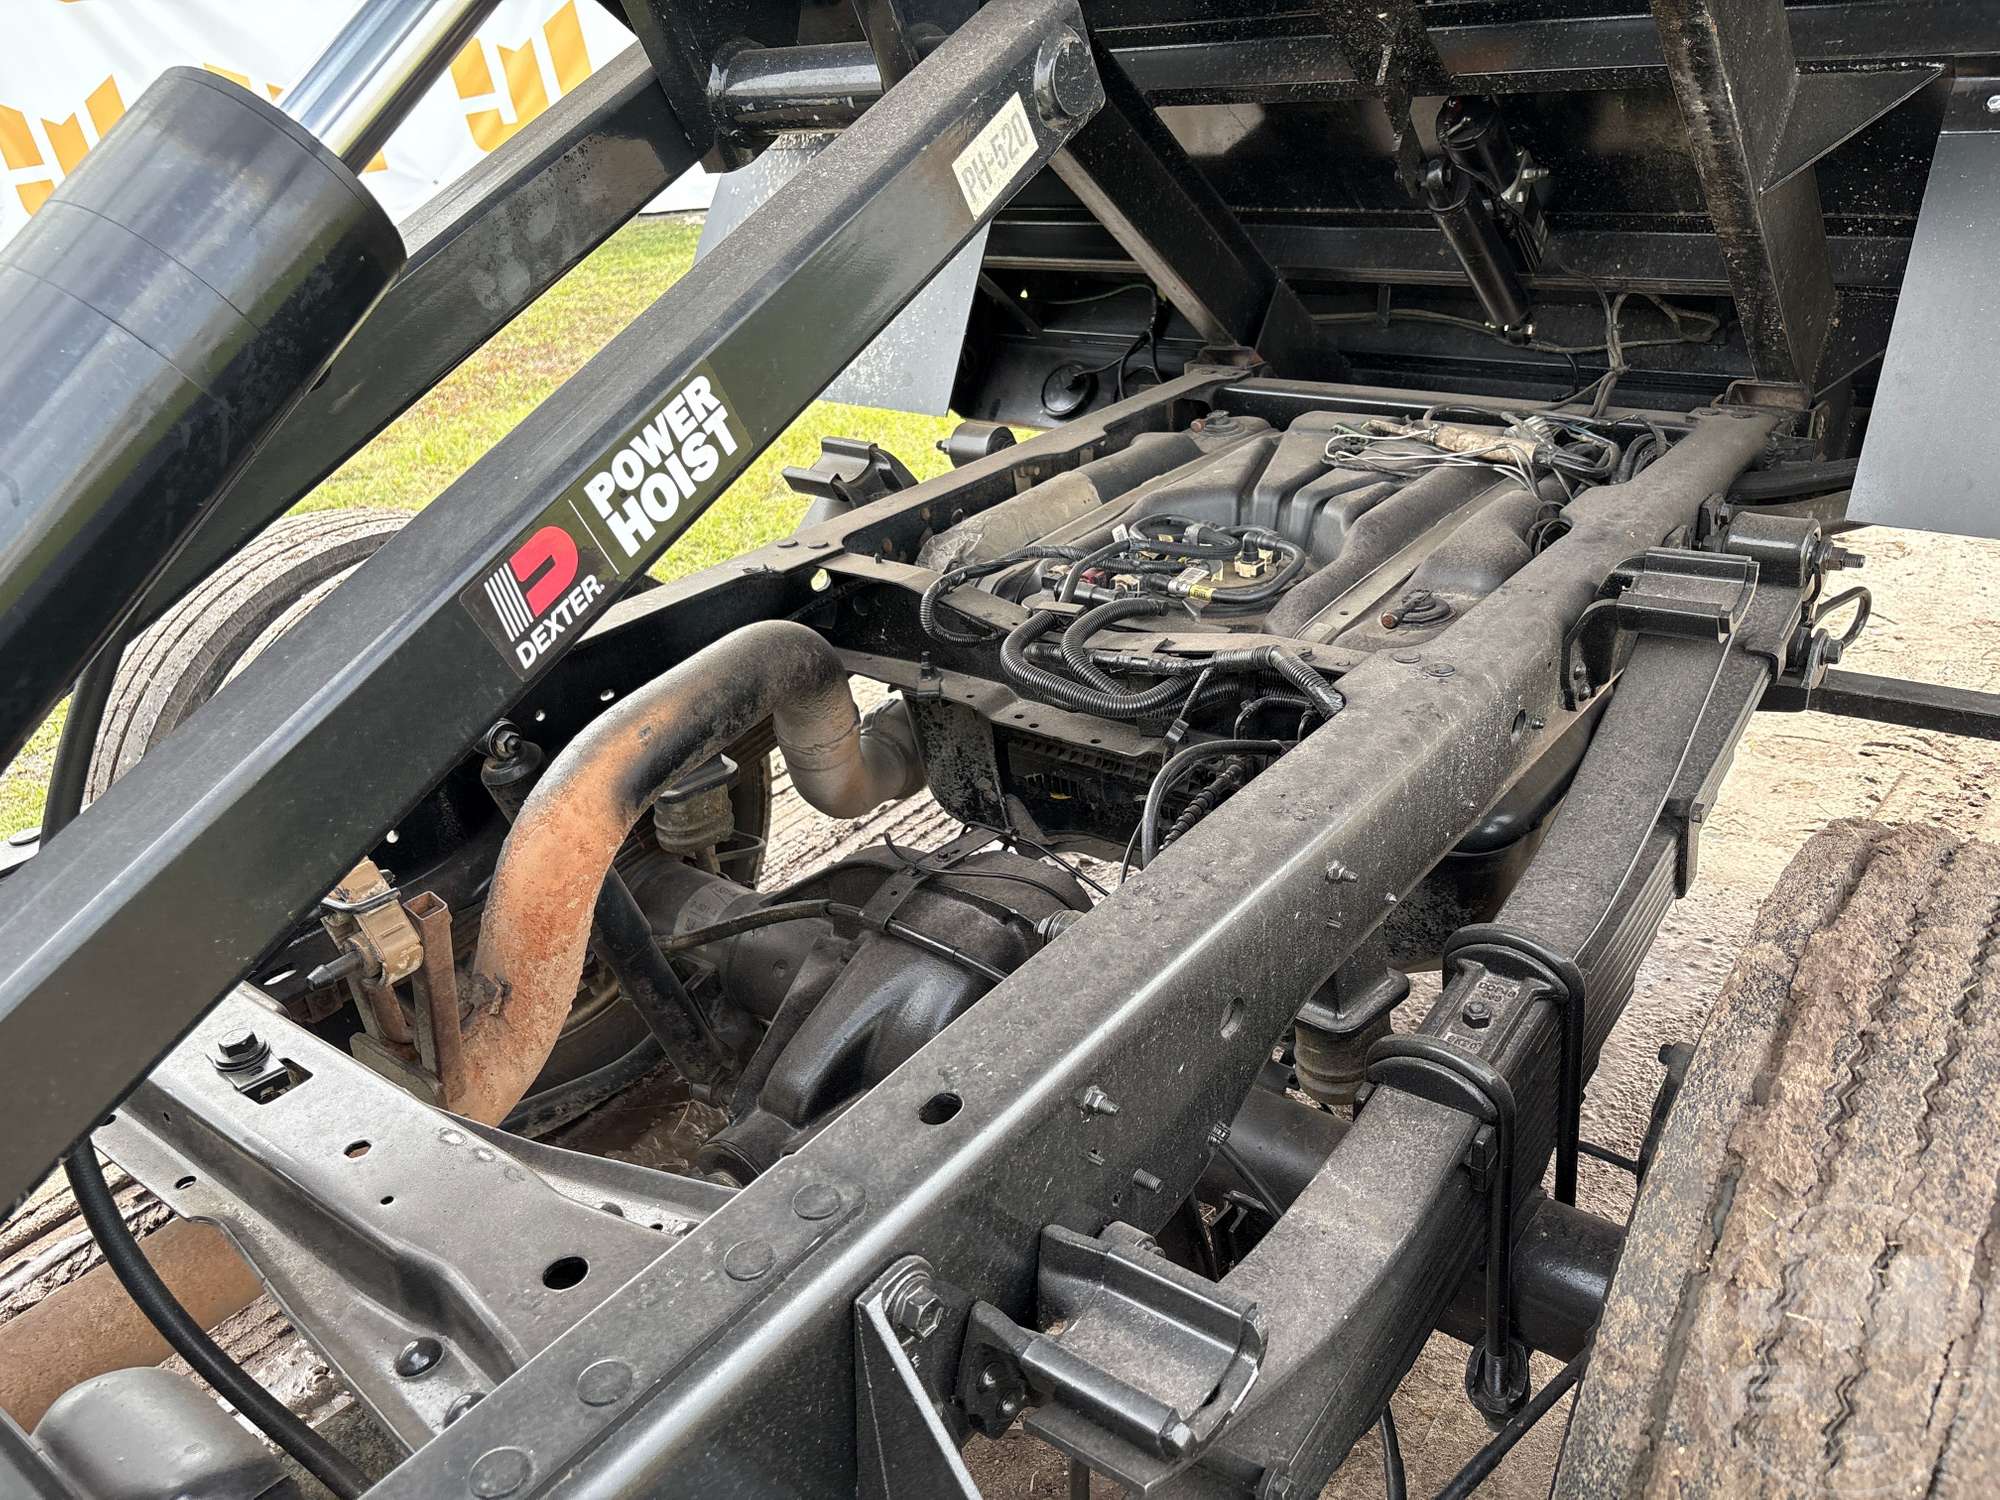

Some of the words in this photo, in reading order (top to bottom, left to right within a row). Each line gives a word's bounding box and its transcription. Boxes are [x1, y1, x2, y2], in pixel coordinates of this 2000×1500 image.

[961, 111, 1029, 204] PH-520
[583, 375, 721, 519] POWER
[606, 405, 738, 558] HOIST
